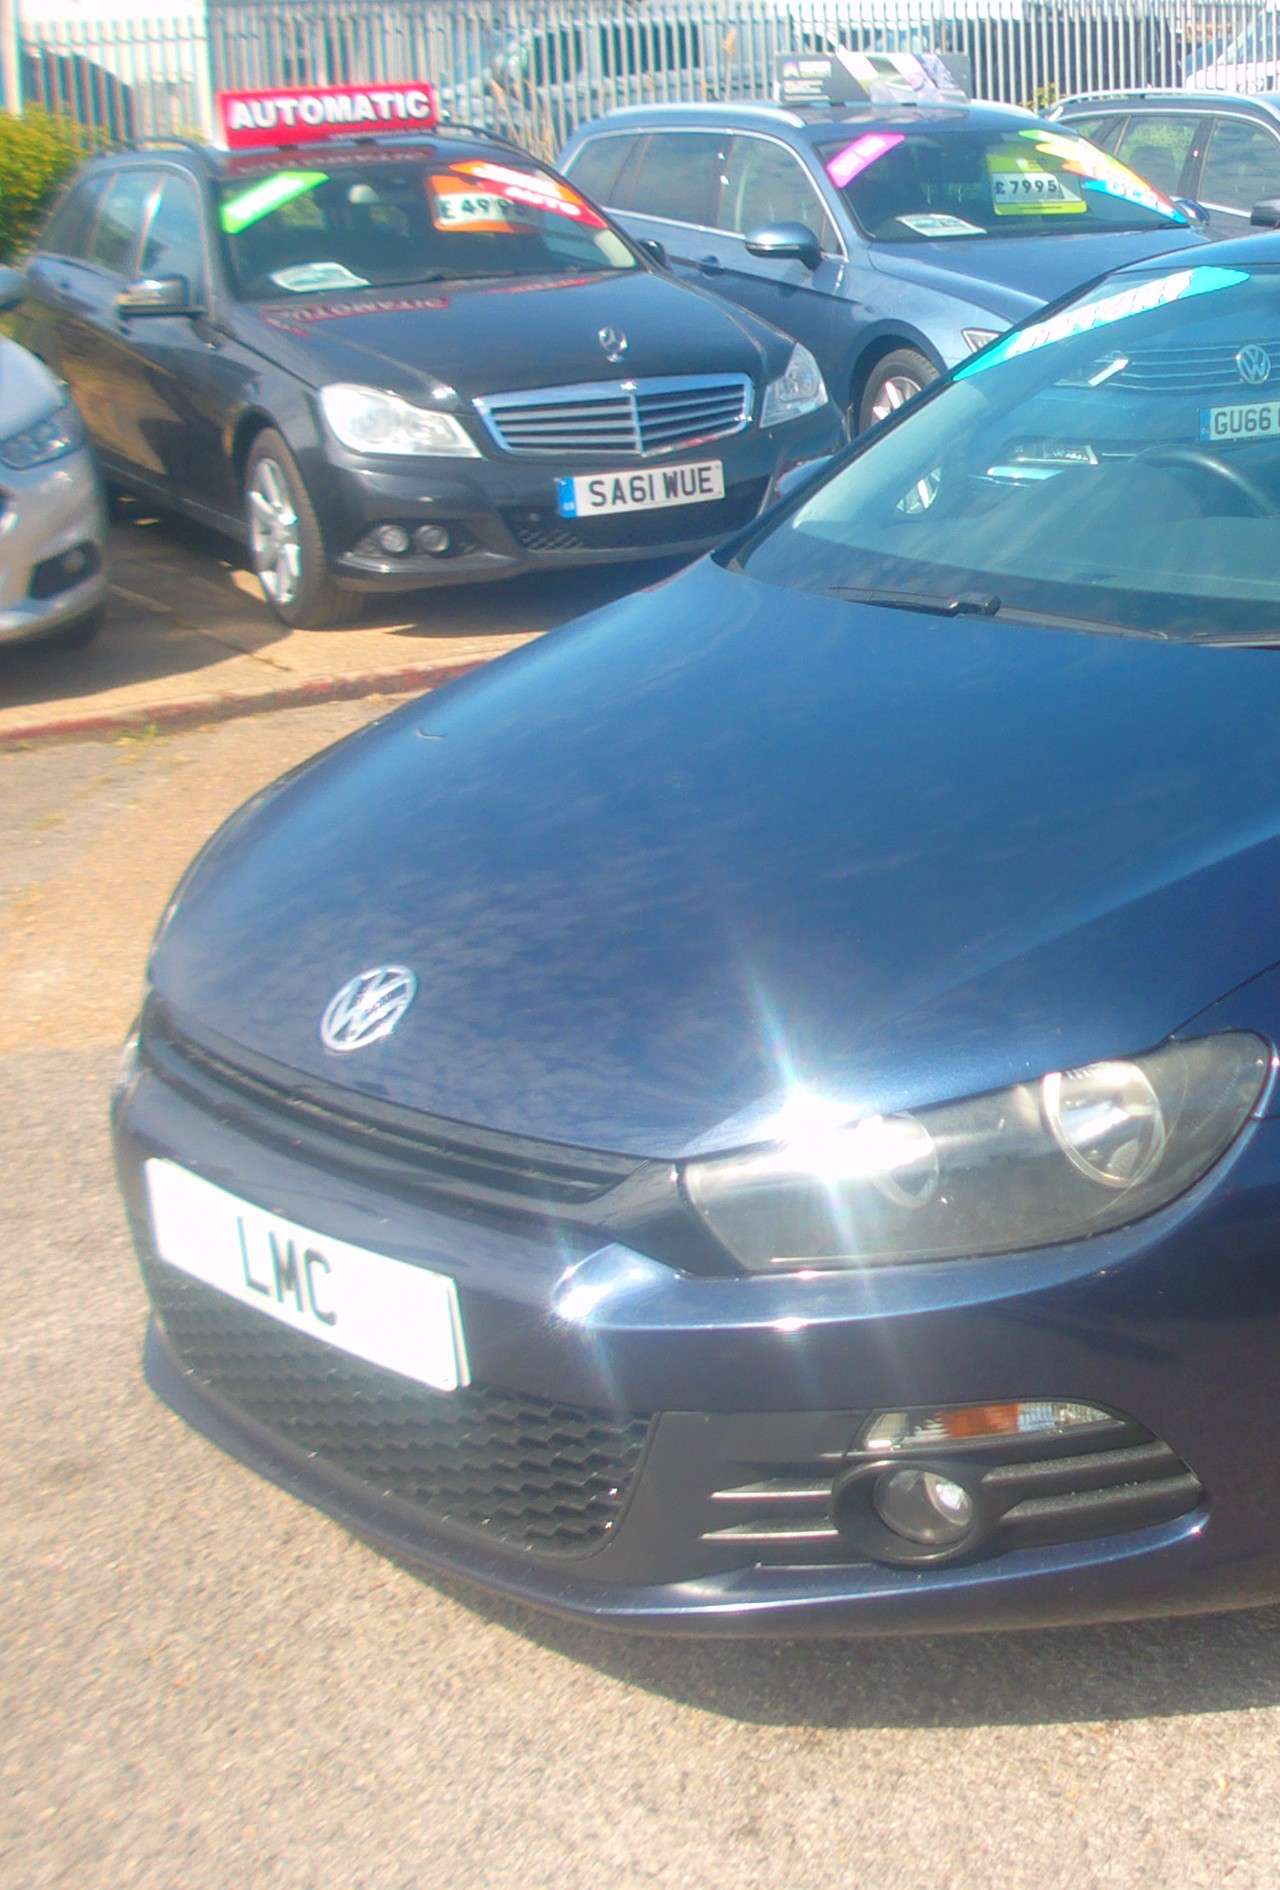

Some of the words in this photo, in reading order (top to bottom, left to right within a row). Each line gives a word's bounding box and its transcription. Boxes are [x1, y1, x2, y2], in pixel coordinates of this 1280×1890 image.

[229, 91, 430, 130] AUTOMATIC
[1213, 407, 1272, 436] GU66
[588, 474, 655, 507] SA61
[663, 466, 714, 499] WUE
[237, 1215, 338, 1327] LMC
